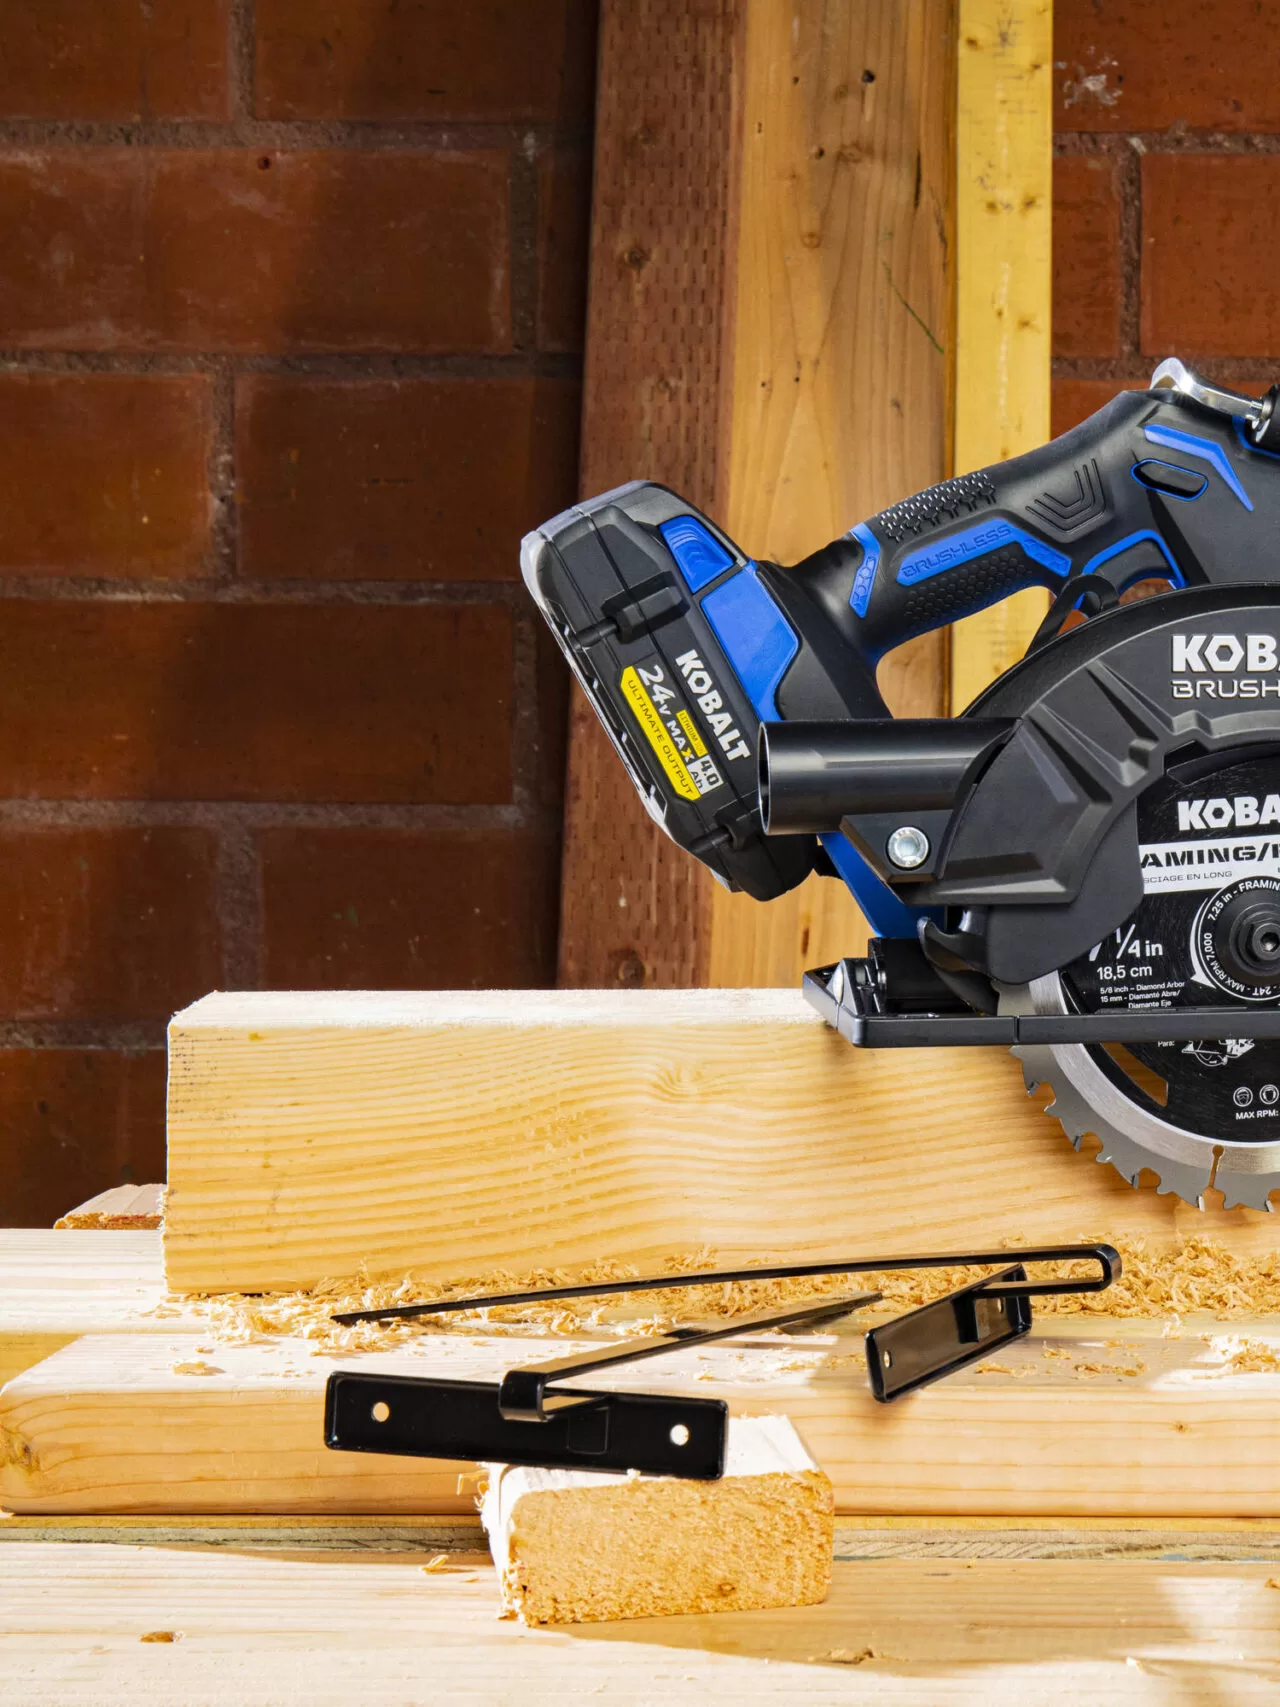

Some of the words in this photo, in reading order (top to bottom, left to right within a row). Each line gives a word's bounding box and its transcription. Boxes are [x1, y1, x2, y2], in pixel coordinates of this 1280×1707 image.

[901, 524, 1012, 578] BRUSHLESS
[675, 649, 752, 761] KOBALT
[628, 679, 665, 743] ULTIMATE
[662, 746, 694, 794] OUTPUT
[666, 720, 695, 763] MAX
[691, 771, 704, 789] Ah
[700, 759, 720, 786] 4.0
[1143, 873, 1183, 884] SCIAGE
[1187, 873, 1200, 881] EN
[1203, 871, 1232, 879] LONG
[1207, 902, 1223, 921] 7.25
[1221, 893, 1233, 903] in
[1145, 940, 1163, 957] in
[1097, 965, 1126, 981] 18,5
[1130, 966, 1153, 978] cm
[1210, 960, 1227, 979] RPM
[1100, 986, 1113, 994] 5/8
[1114, 985, 1129, 993] inch
[1136, 982, 1166, 991] Diamond
[1226, 978, 1245, 992] MAX
[1252, 987, 1272, 996] 24T
[1100, 995, 1109, 1003] 15
[1235, 1111, 1255, 1120] MAX
[1256, 1110, 1279, 1118] RPM:
